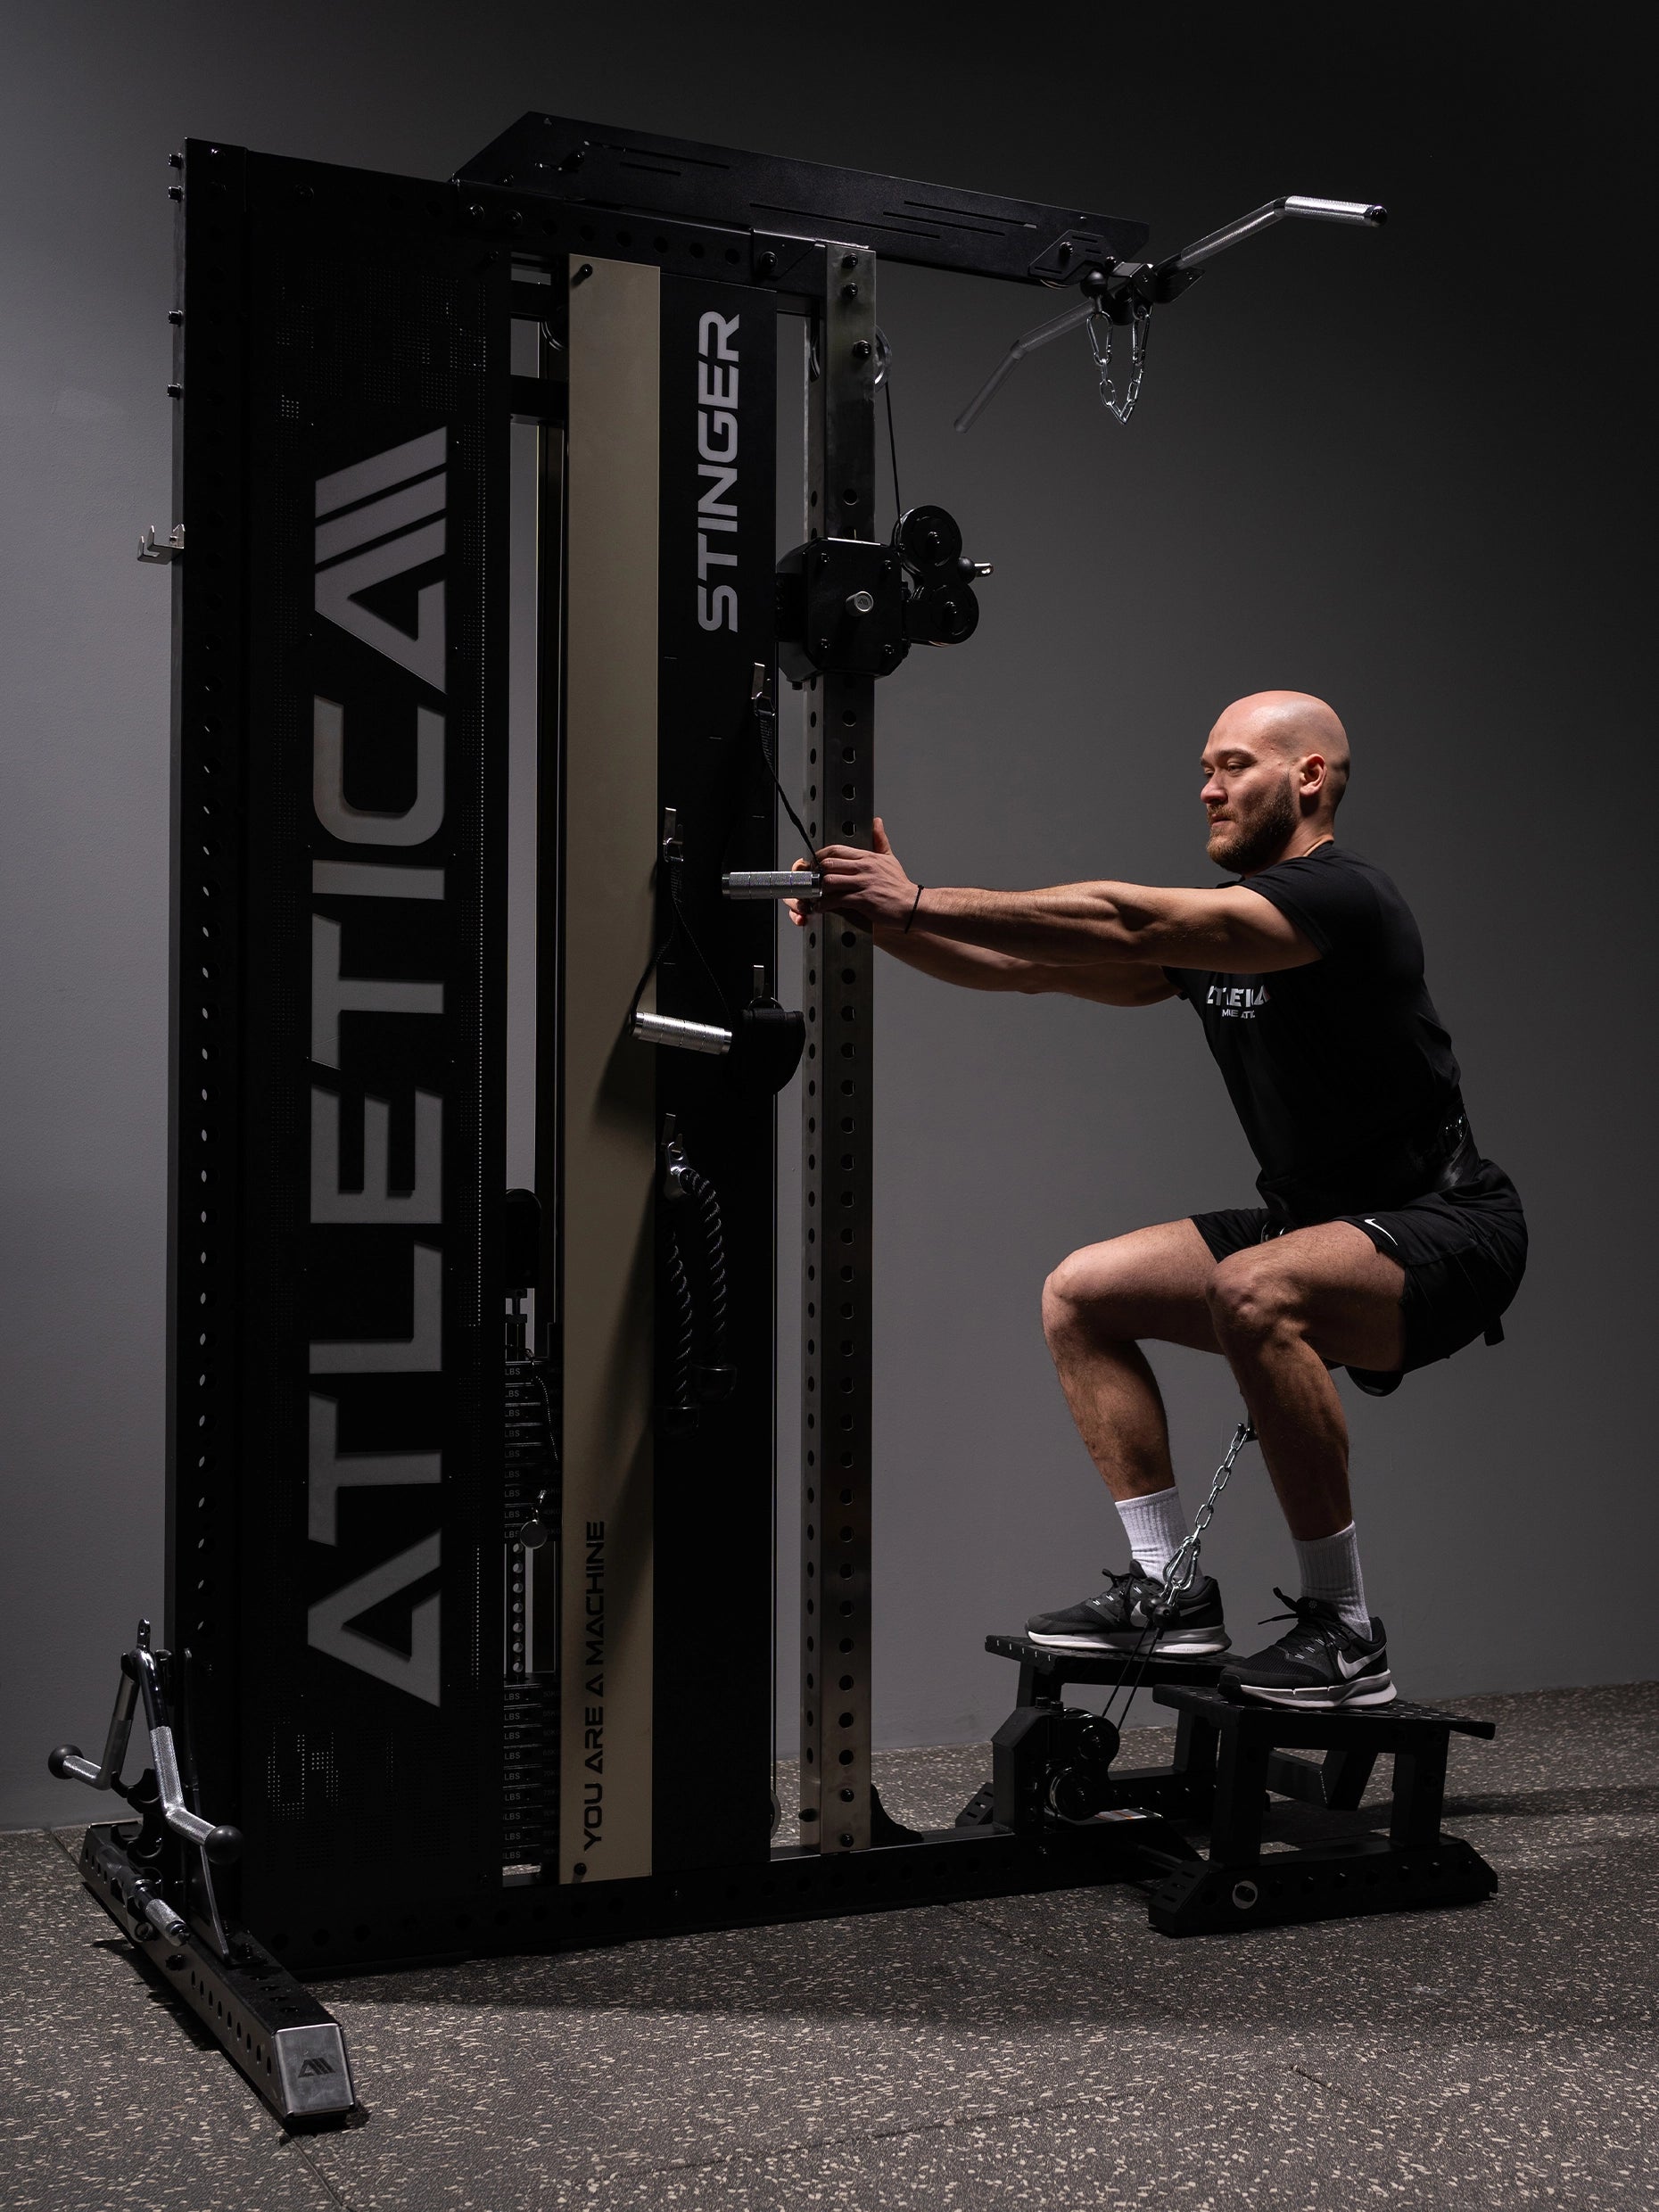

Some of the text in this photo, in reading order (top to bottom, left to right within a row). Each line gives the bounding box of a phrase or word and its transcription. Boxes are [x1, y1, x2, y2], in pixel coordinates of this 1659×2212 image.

[698, 310, 740, 632] STINGER
[308, 425, 447, 1708] ATLETICA
[584, 1521, 605, 1852] YOU ARE A MACHINE
